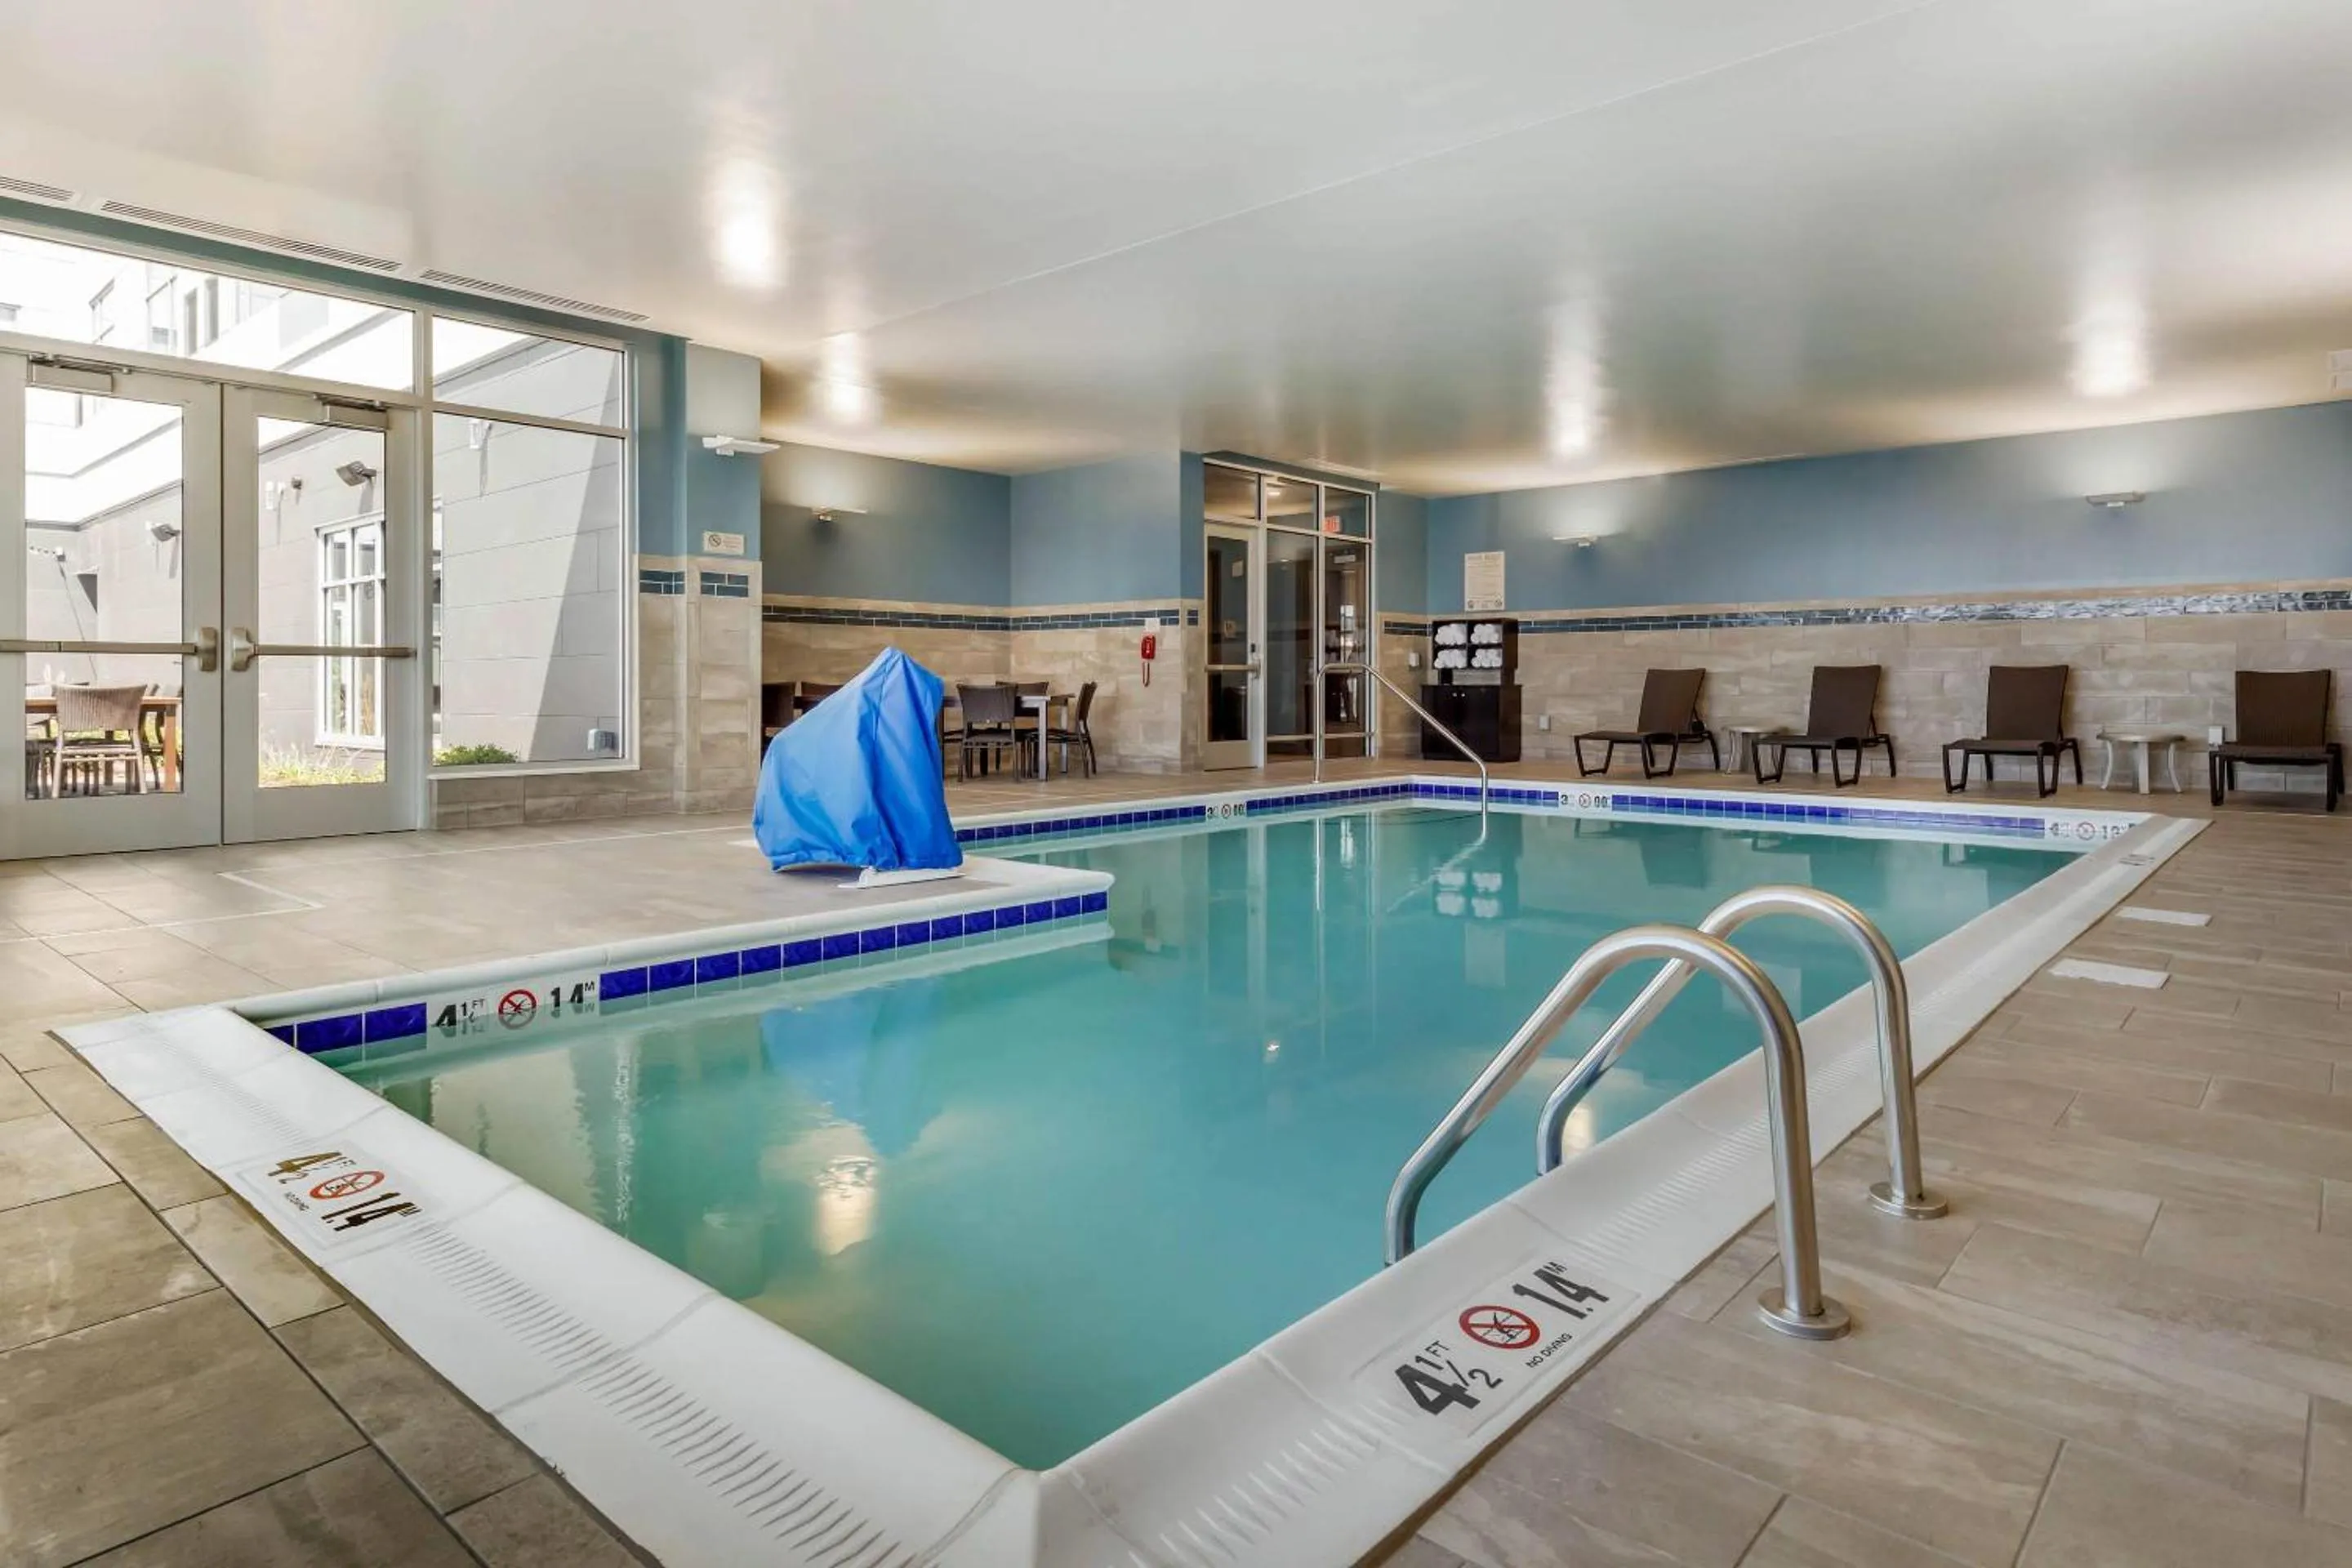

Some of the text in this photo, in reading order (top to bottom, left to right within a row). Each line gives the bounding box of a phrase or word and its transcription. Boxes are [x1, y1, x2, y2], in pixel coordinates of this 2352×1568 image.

[1425, 1339, 1450, 1358] FT
[1526, 1332, 1573, 1369] NO DIVING
